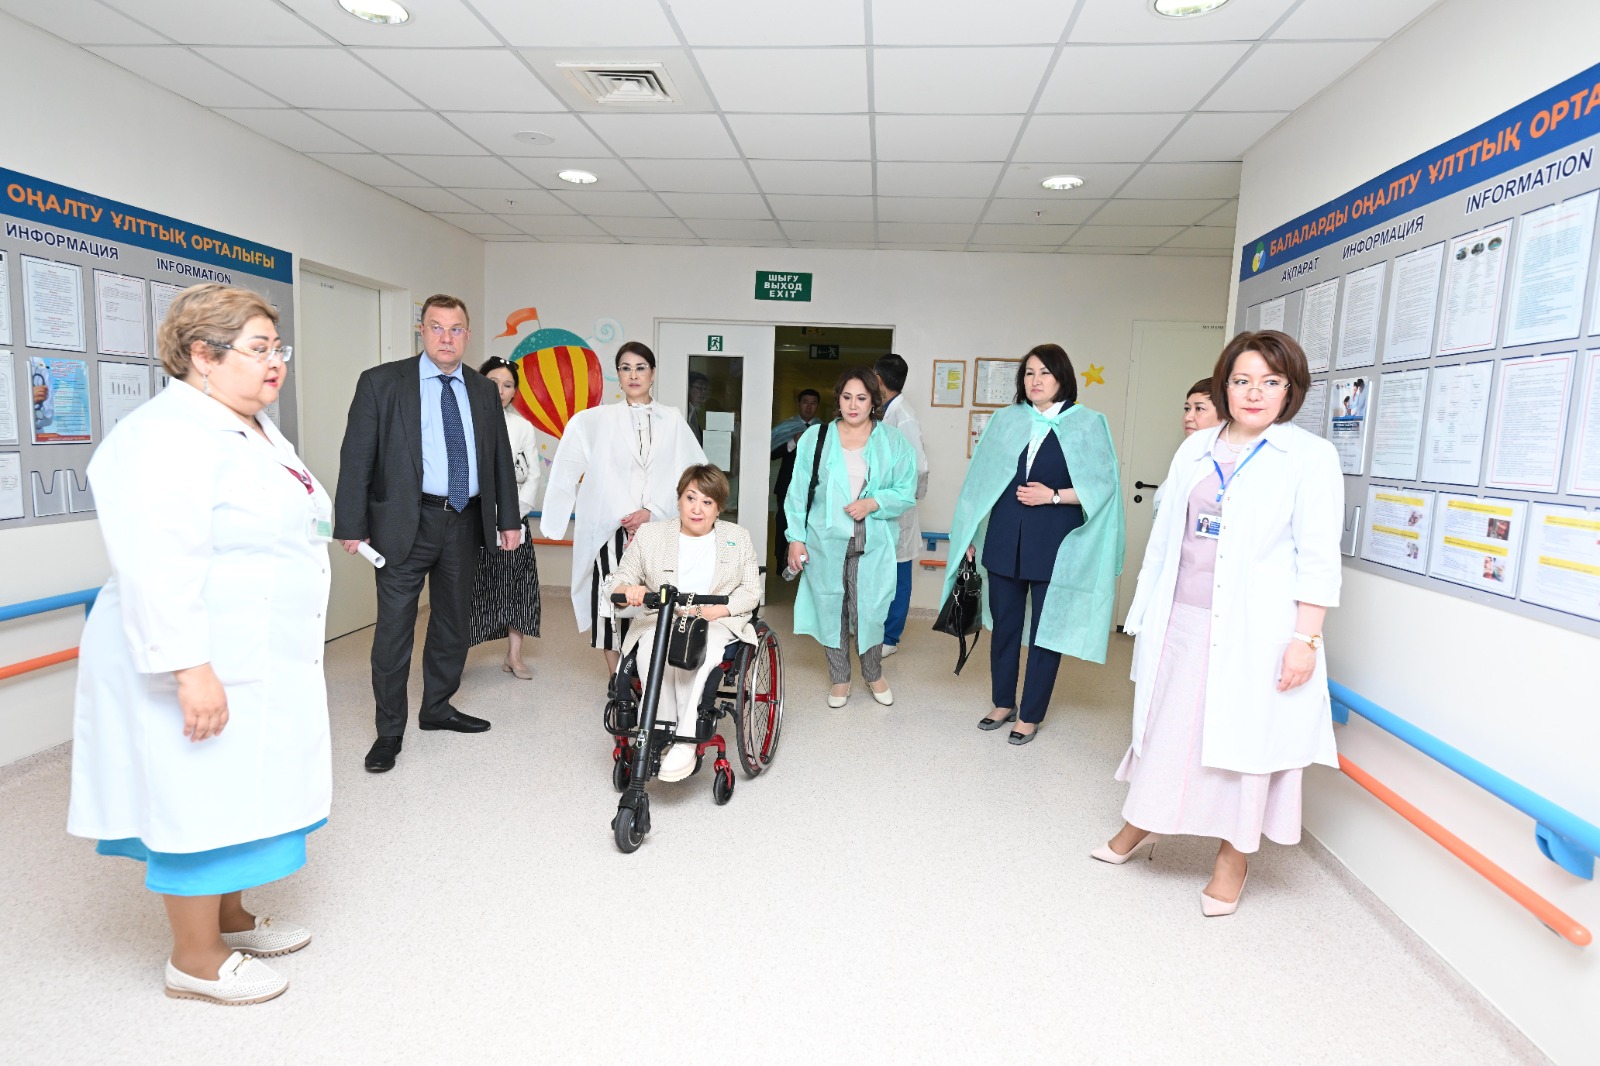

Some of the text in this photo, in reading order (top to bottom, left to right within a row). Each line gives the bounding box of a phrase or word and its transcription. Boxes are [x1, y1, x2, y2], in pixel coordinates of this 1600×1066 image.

[1269, 205, 1349, 257] БАЛАЛАРДЫ
[1352, 170, 1422, 219] ОҢАЛТУ
[1428, 121, 1522, 185] ҰЛТТЫҚ
[1465, 147, 1594, 215] INFORMATION
[5, 222, 120, 261] ИНФОРМАЦИЯ
[7, 183, 276, 270] ОҢАЛТУ ҰЛТТЫҚ ОРТАЛЫҒЫ
[1342, 214, 1425, 260] ИНФОРМАЦИЯ
[156, 257, 232, 285] INFORMATION
[764, 282, 802, 291] ВЫХОД
[1281, 256, 1320, 283] АҚПАРАТ
[769, 290, 796, 298] EXIT
